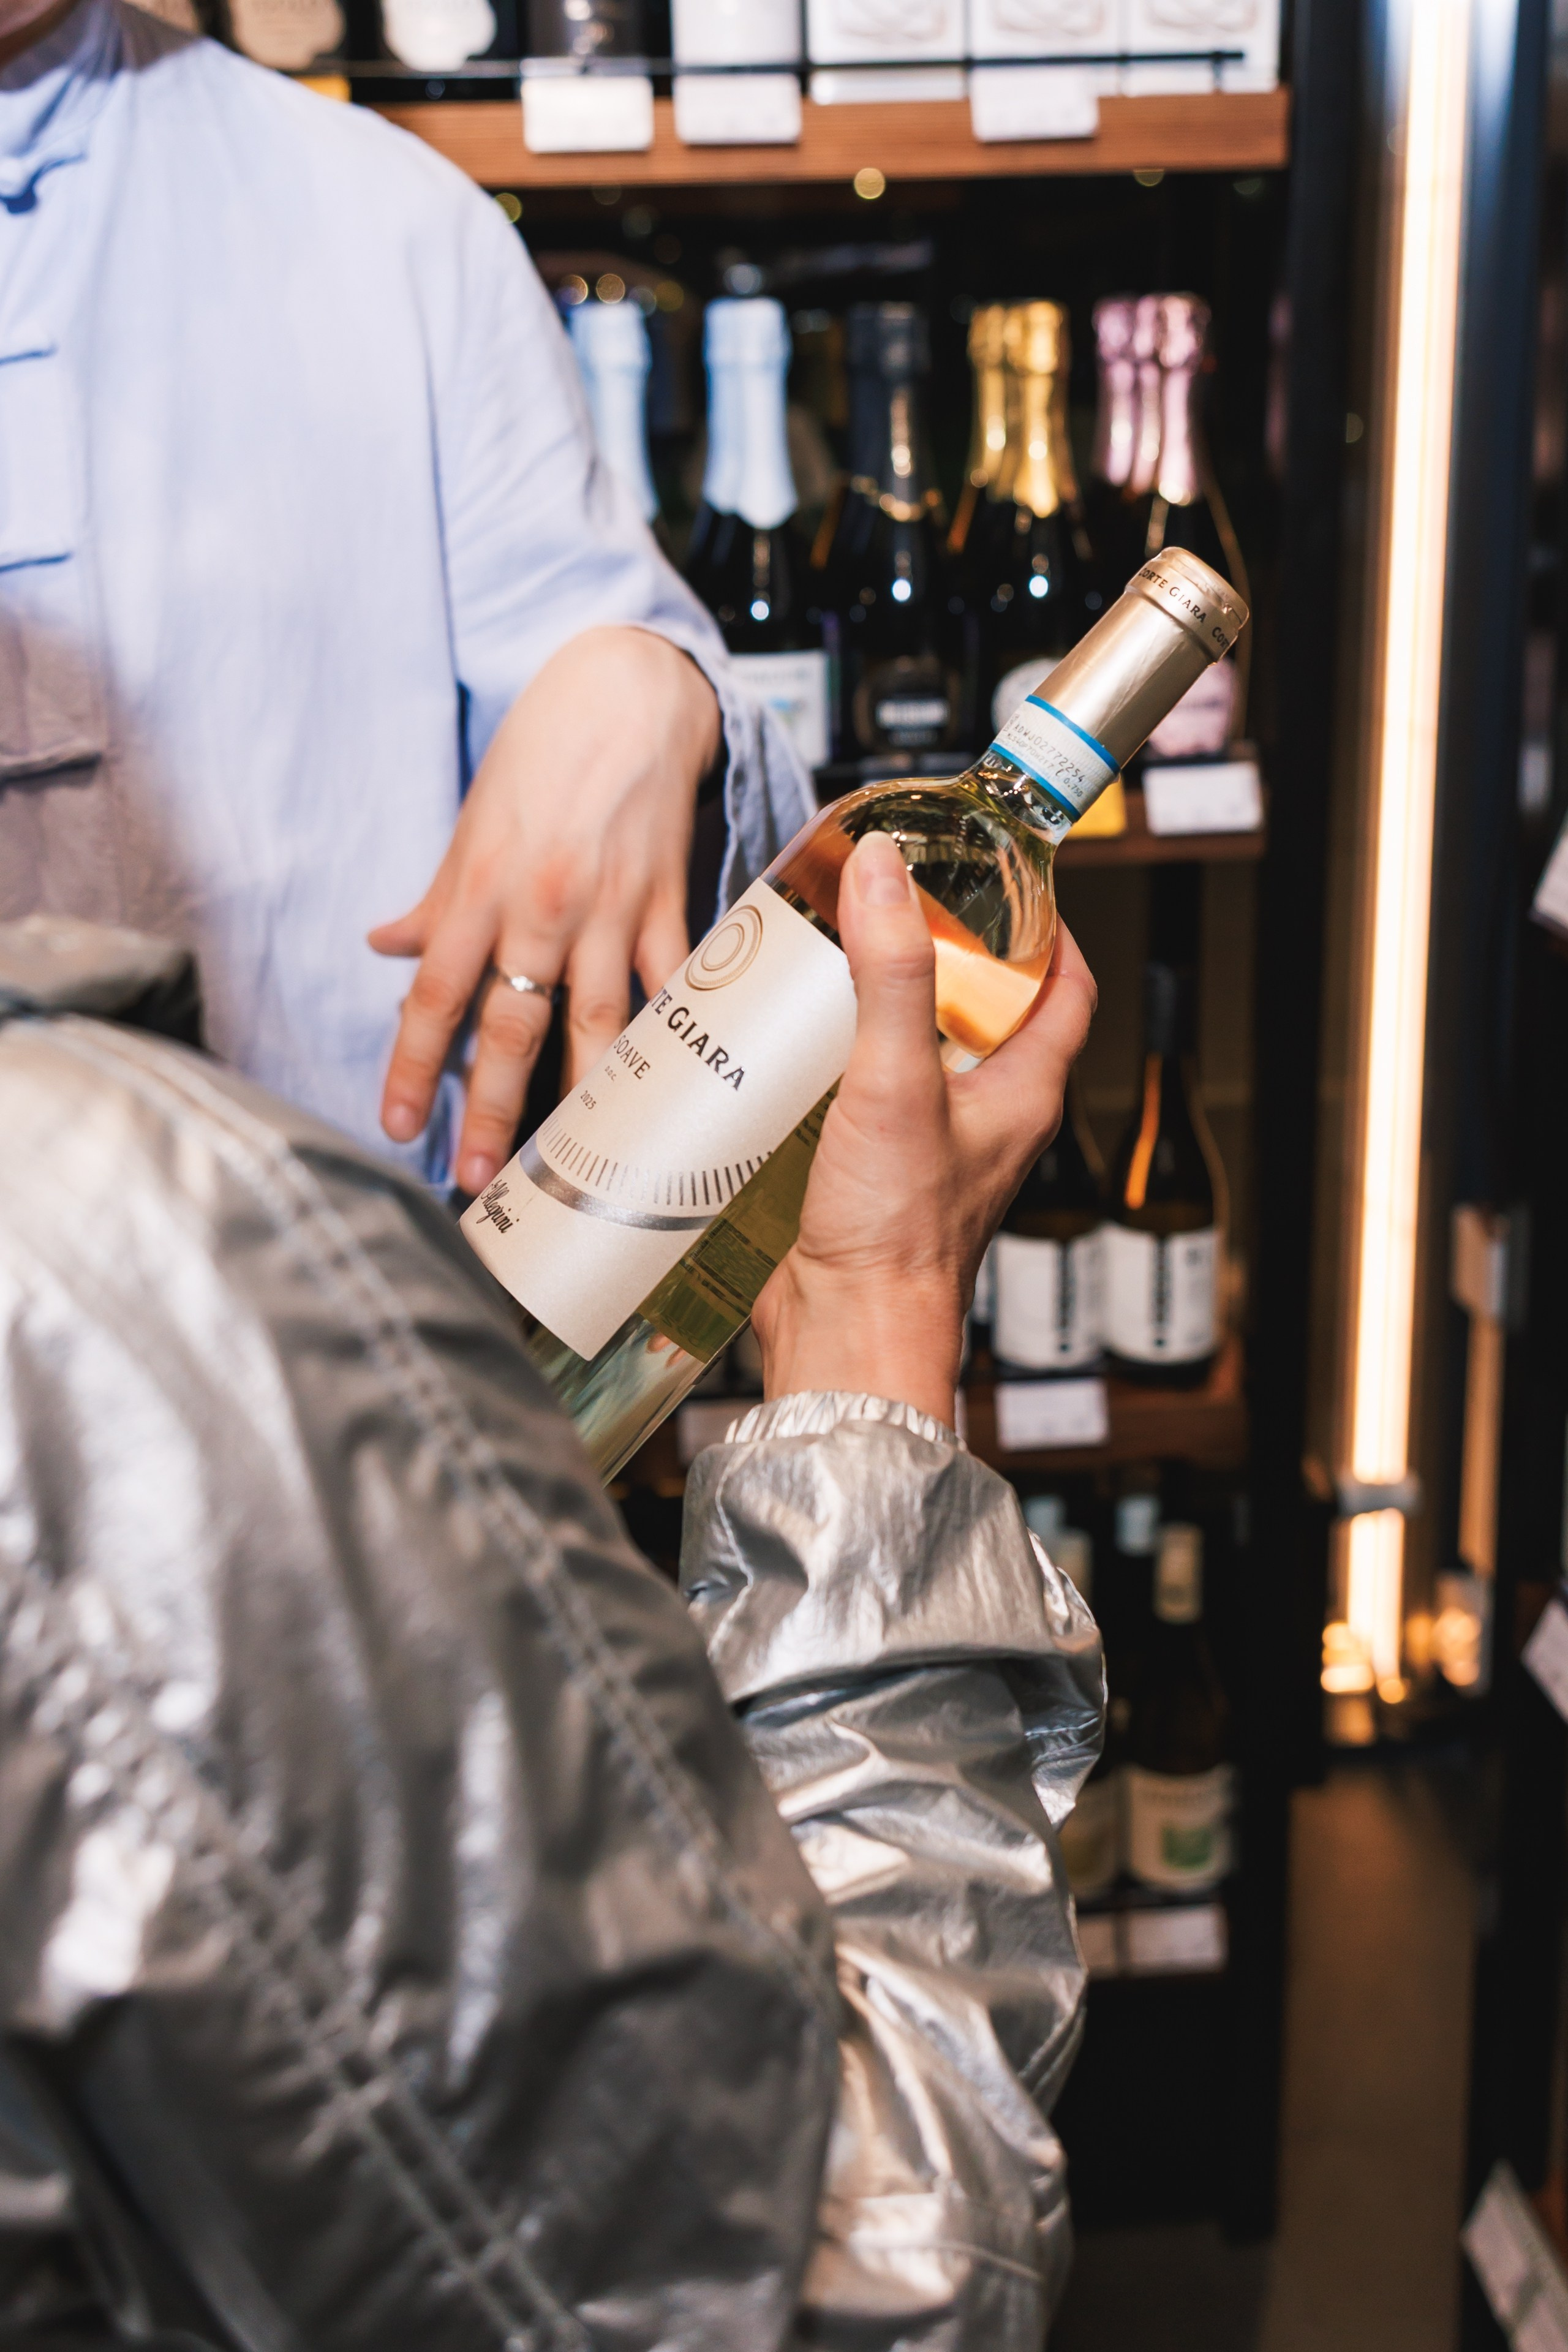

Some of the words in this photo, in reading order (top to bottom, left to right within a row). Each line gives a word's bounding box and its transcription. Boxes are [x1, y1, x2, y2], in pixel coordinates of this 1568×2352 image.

[1169, 586, 1207, 624] GIARA
[613, 1035, 650, 1080] SOAVE
[668, 1006, 745, 1091] GIARA
[580, 1090, 597, 1110] 2025
[476, 1182, 520, 1234] Allegrini
